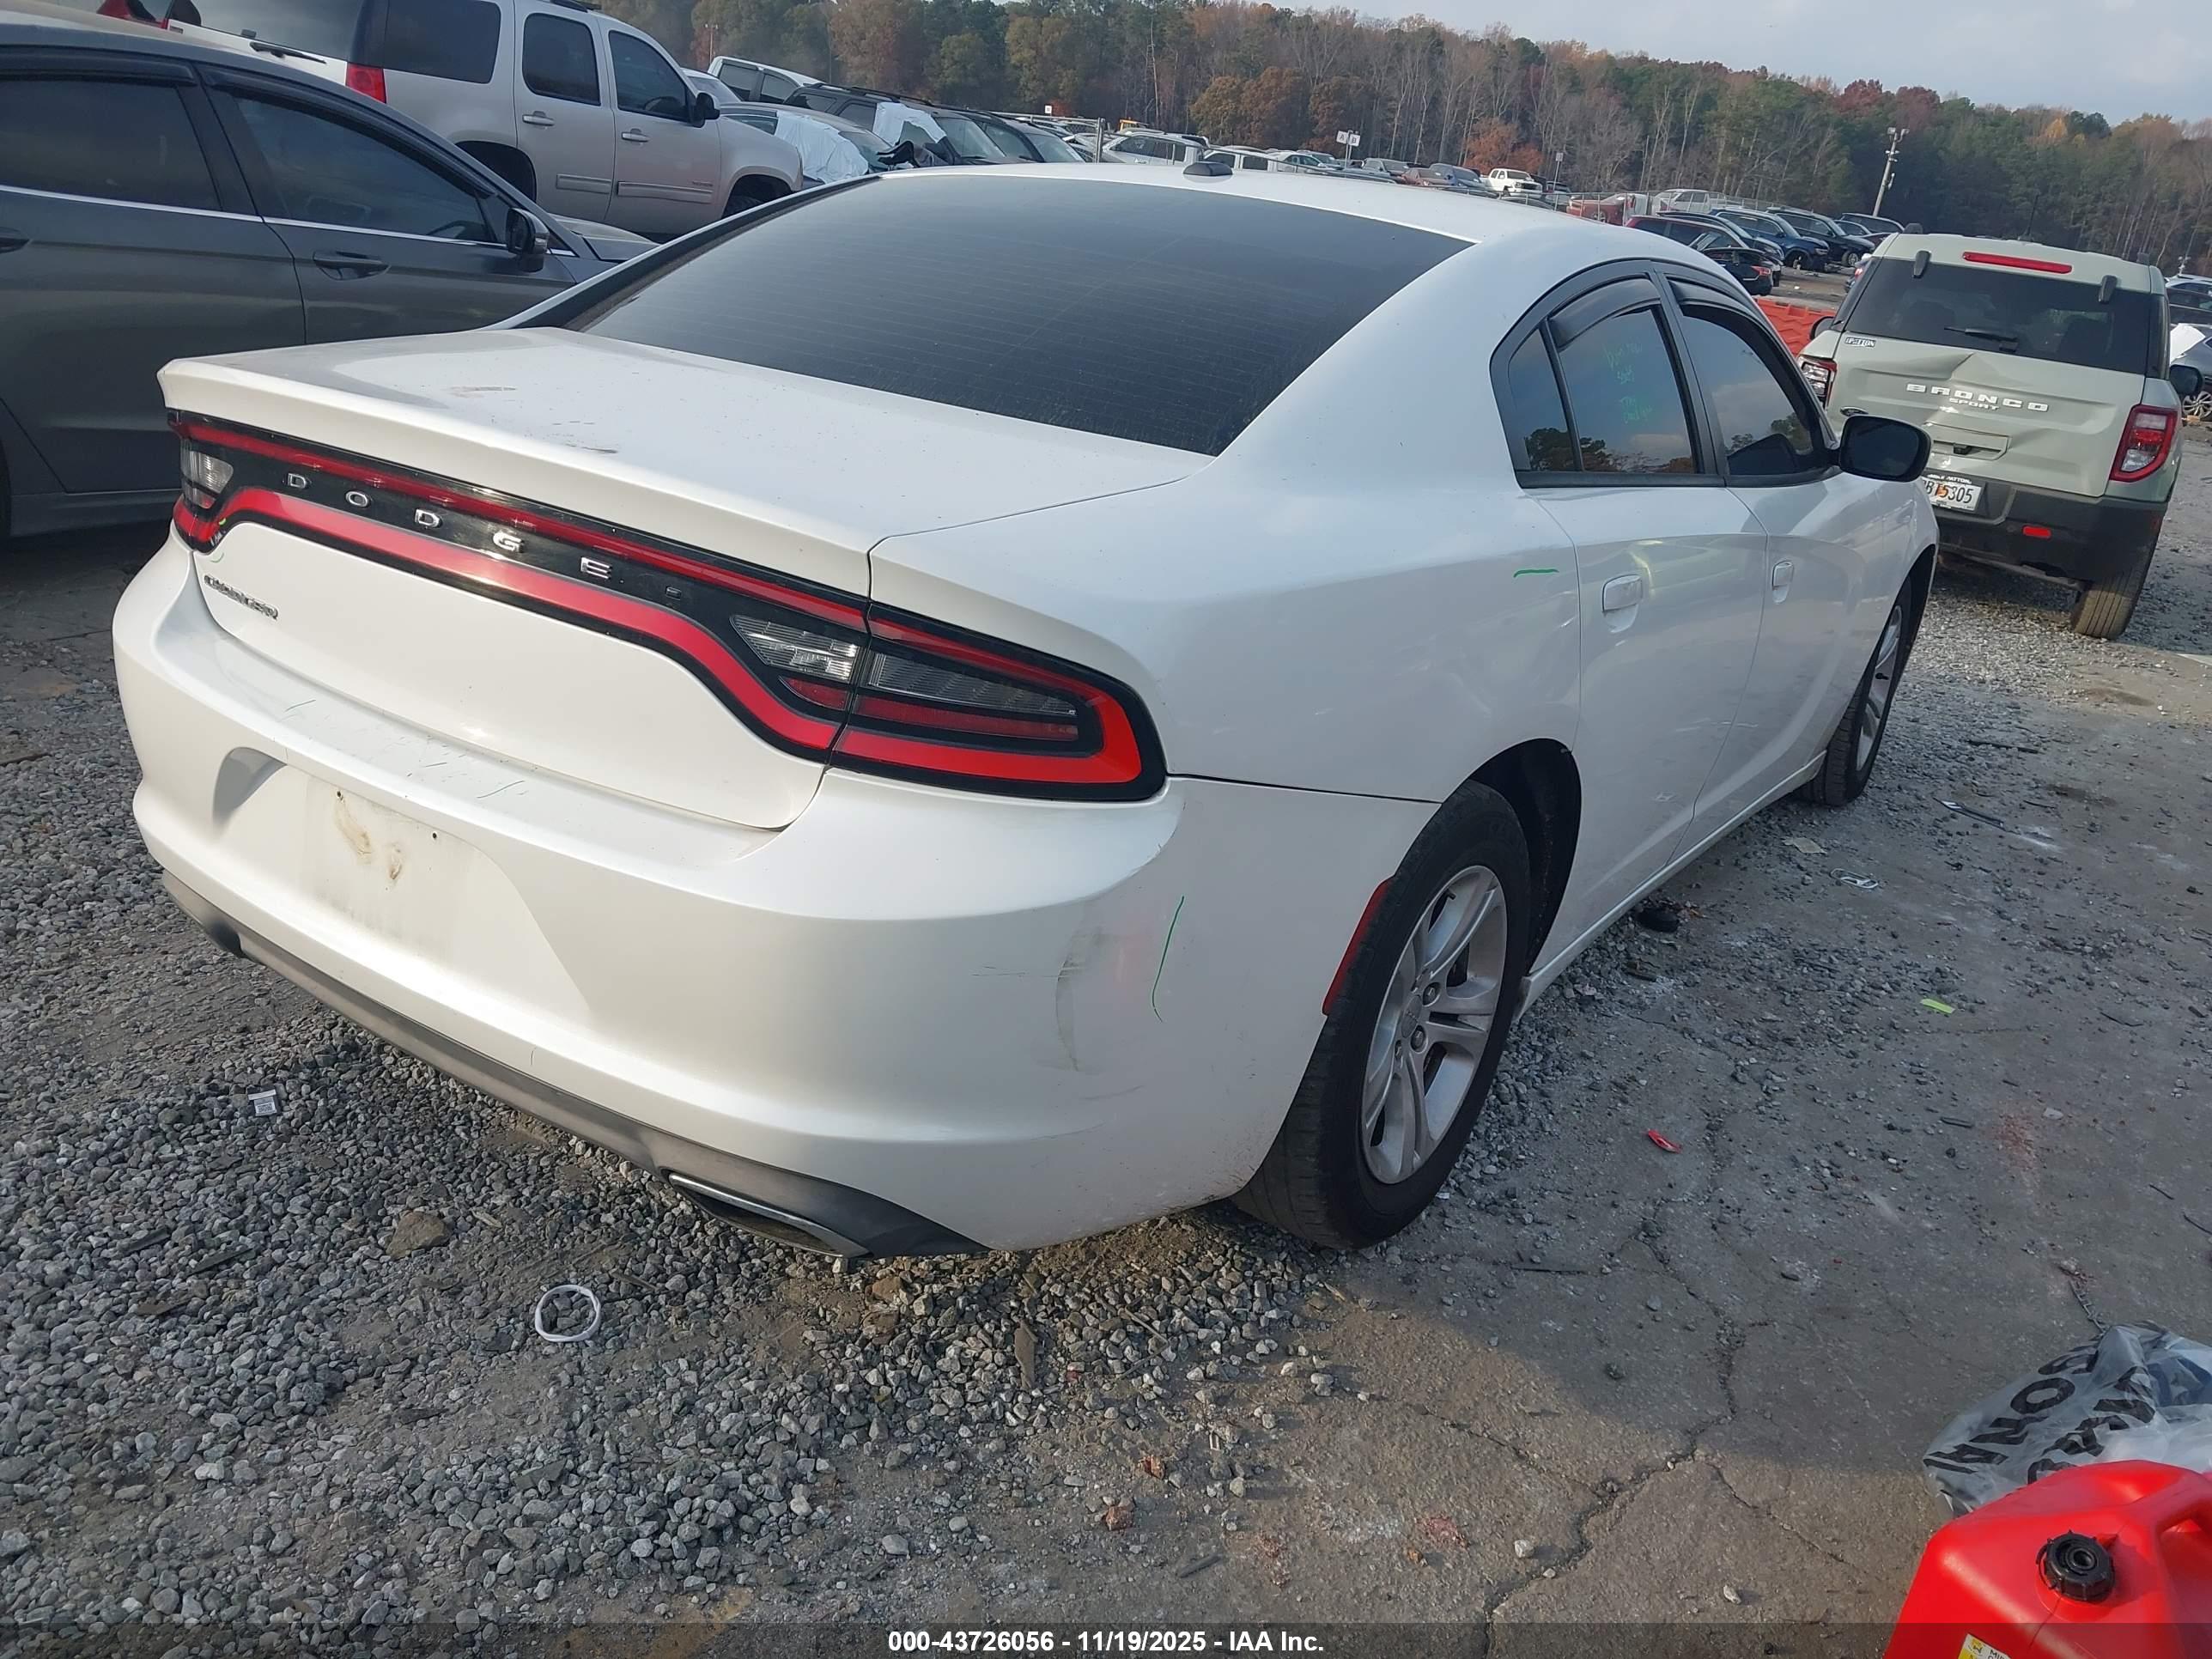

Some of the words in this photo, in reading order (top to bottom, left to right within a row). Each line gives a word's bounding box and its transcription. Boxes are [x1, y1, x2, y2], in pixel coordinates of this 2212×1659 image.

[1905, 383, 2050, 412] BRONCO
[1948, 398, 2001, 410] SPORT
[287, 472, 613, 580] DODGE
